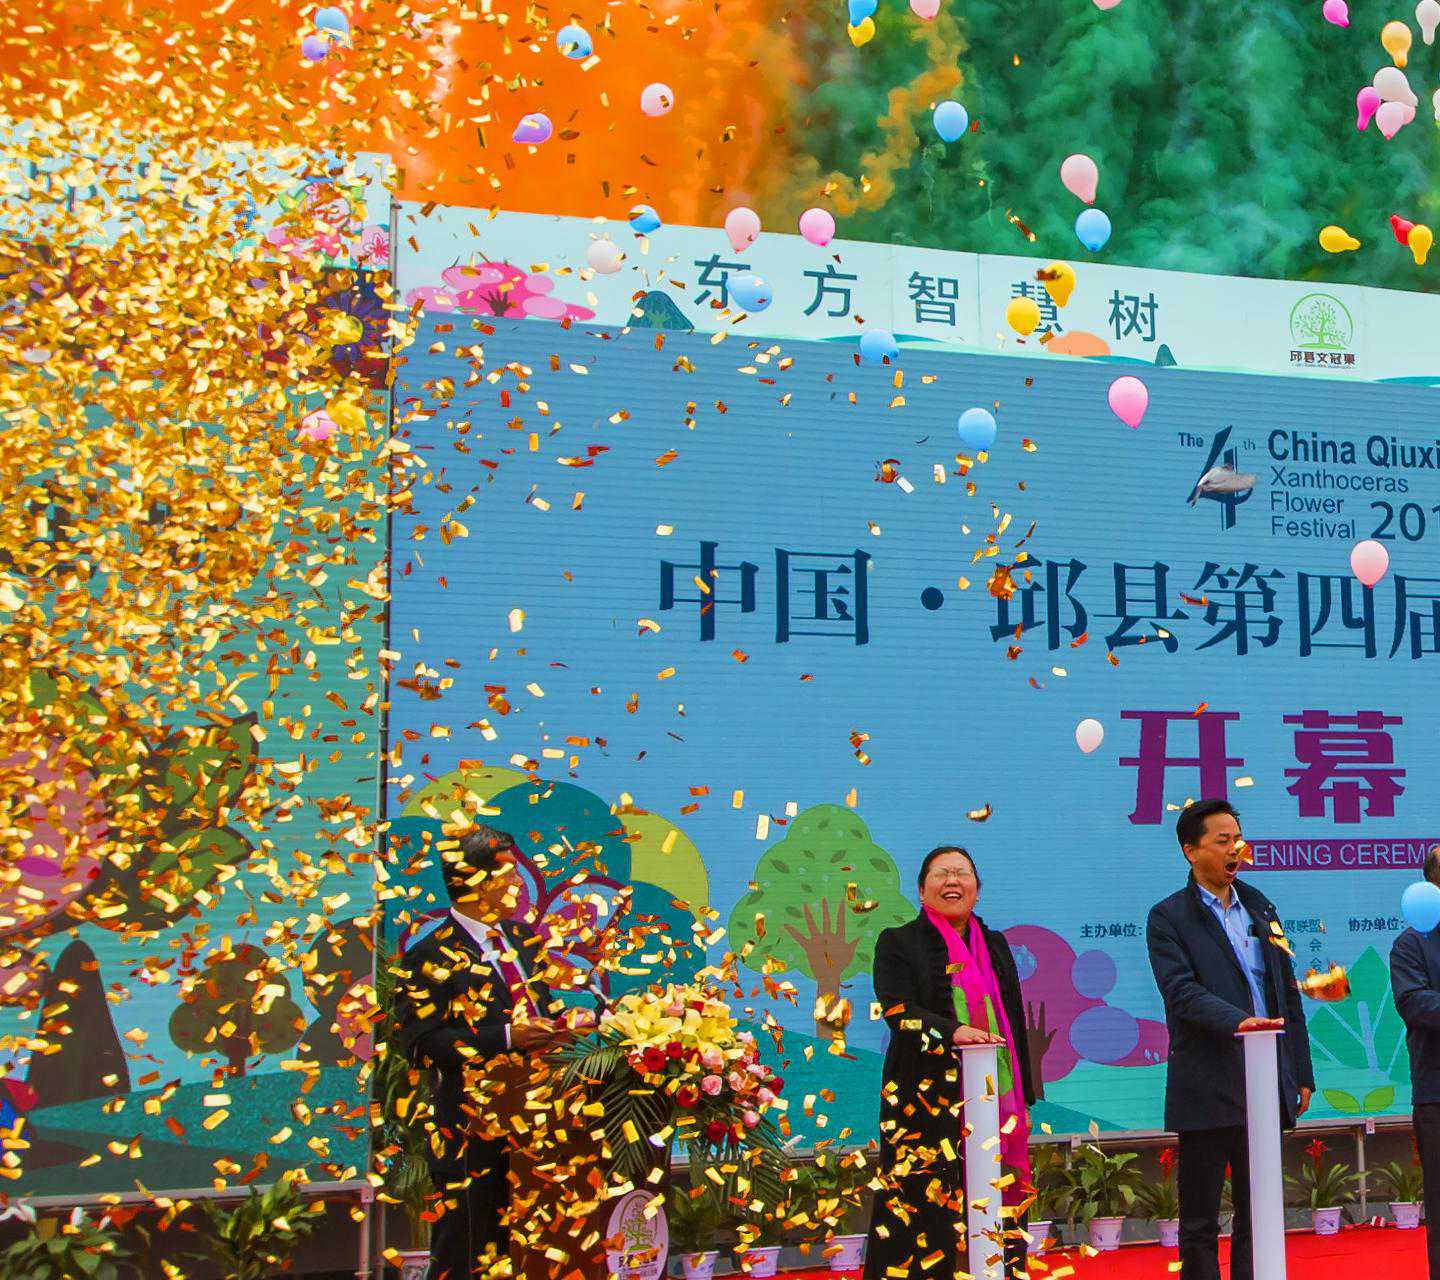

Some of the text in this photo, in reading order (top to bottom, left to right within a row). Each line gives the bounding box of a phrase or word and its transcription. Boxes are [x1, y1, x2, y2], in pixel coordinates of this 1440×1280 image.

[1178, 432, 1204, 448] The
[1268, 429, 1357, 465] China
[1270, 466, 1409, 493] Xanthoceras
[1270, 491, 1345, 514] Flower
[1271, 516, 1356, 540] Festival
[1253, 844, 1333, 866] ENING
